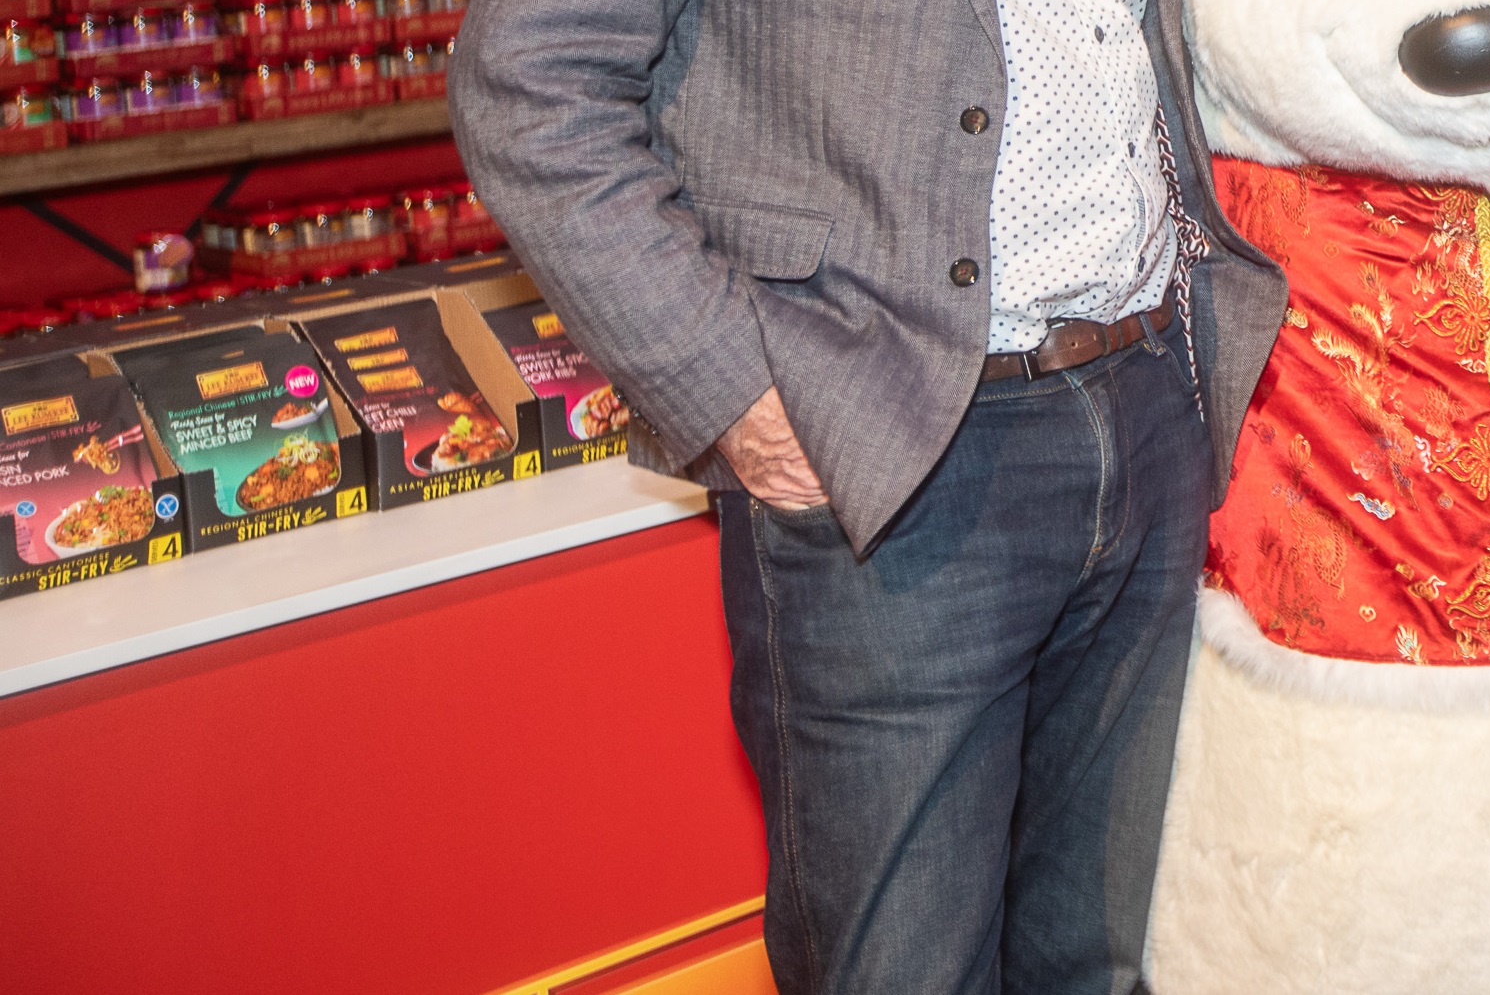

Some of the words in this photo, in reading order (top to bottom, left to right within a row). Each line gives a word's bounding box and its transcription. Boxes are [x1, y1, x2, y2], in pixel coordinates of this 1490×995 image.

[289, 375, 315, 391] NEW
[168, 404, 203, 420] Regional
[204, 400, 236, 413] Chinese
[176, 424, 213, 443] SWEET
[216, 423, 226, 434] &
[227, 413, 257, 433] SPICY
[180, 435, 227, 455] MINCED
[228, 428, 253, 444] BEEF
[34, 464, 70, 483] PORK
[525, 453, 538, 472] 4
[389, 479, 424, 495] ASIAN
[423, 473, 481, 501] STIR-FRY
[349, 489, 364, 511] 4
[201, 517, 250, 537] REGIONAL
[255, 506, 293, 522] CHINESE
[237, 511, 300, 542] STIR-FRY
[162, 536, 178, 558] 4
[0, 569, 42, 586] CLASSIC
[48, 552, 110, 573] CANTONESE
[38, 560, 110, 591] STIR-FRY
